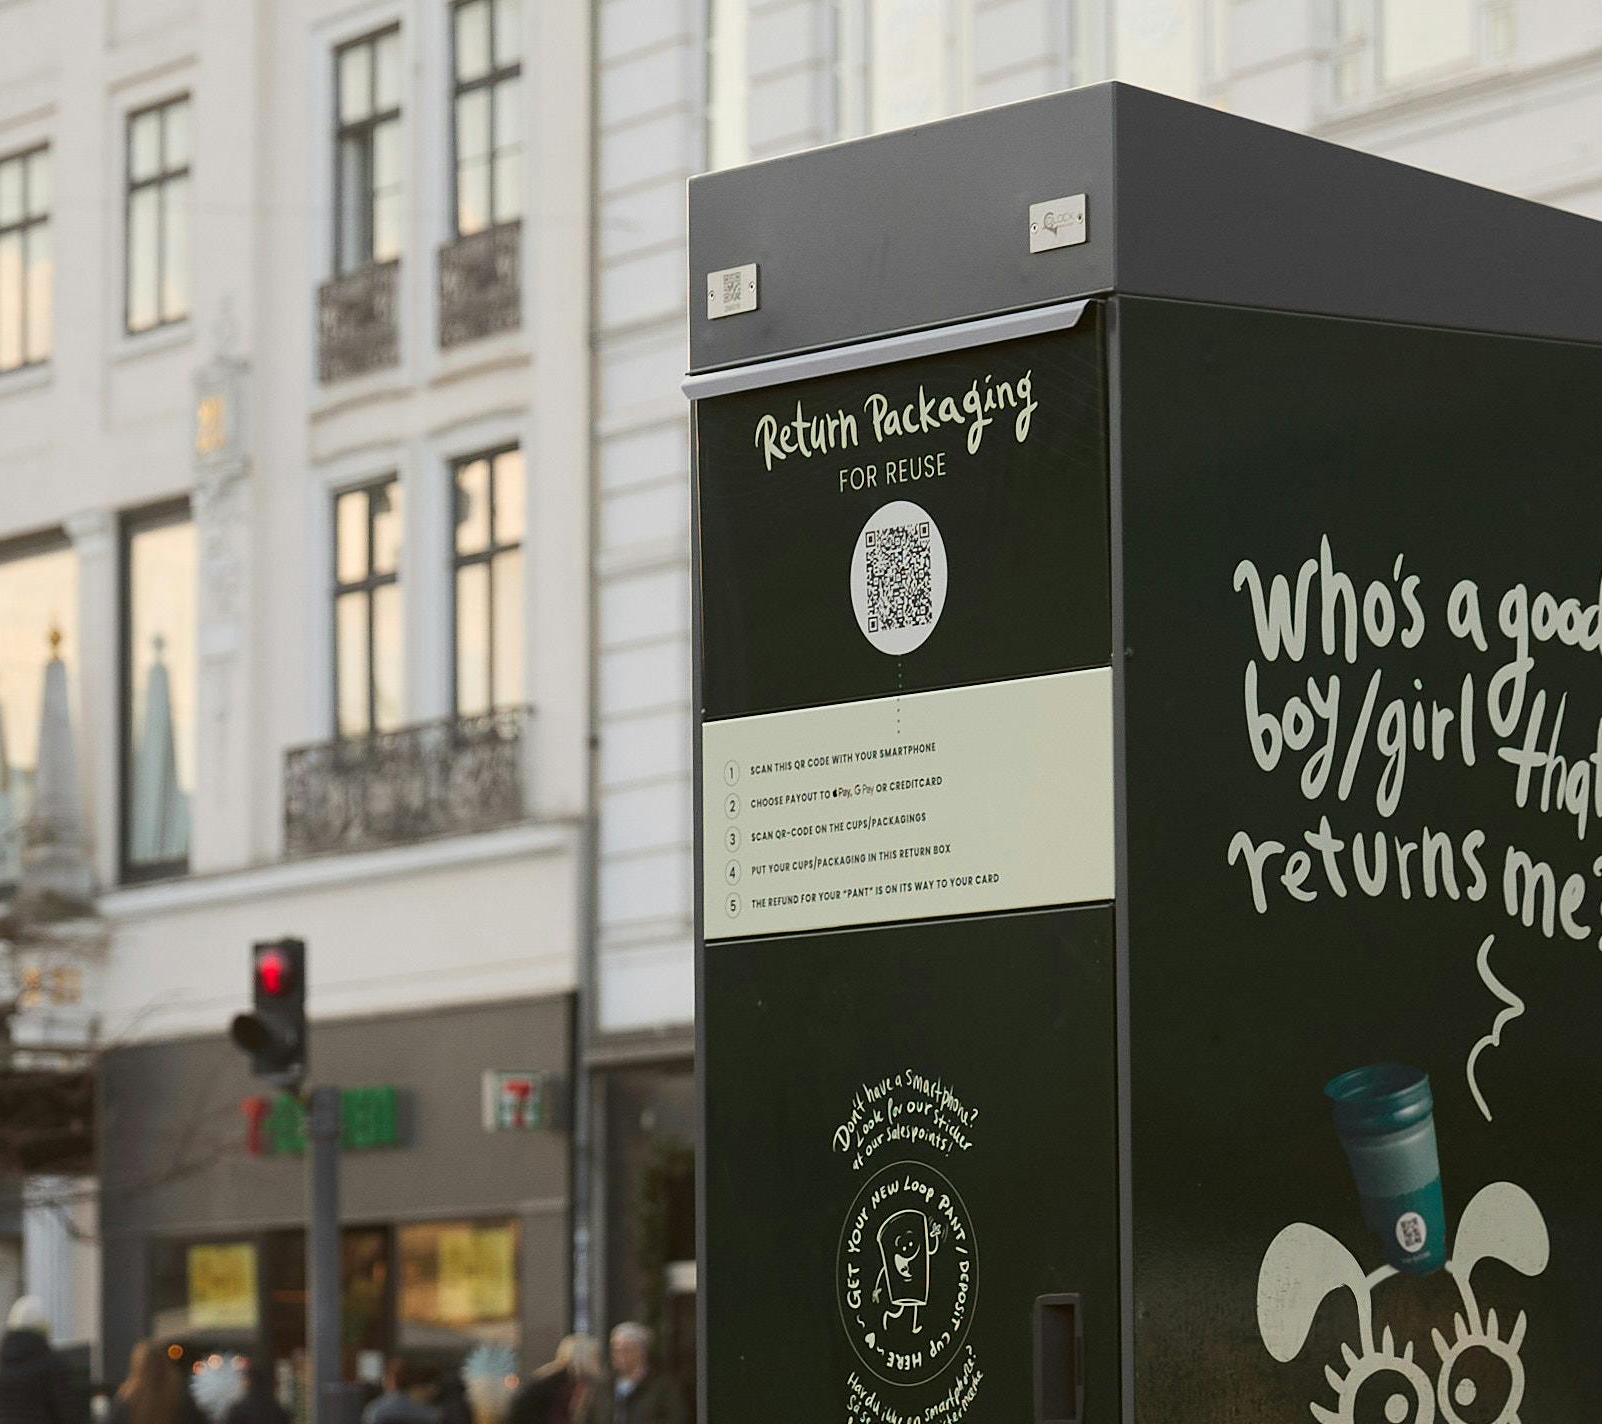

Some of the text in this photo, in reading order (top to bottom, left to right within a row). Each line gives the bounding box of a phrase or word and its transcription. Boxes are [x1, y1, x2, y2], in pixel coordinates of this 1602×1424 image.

[754, 368, 1039, 472] Return Packaging
[838, 452, 947, 493] FOR REUSE
[1232, 533, 1425, 665] Who's
[1446, 579, 1488, 653] a
[1242, 656, 1478, 818] boy/girl
[750, 764, 773, 776] SCAN
[775, 761, 792, 772] THIS
[794, 759, 806, 770] QR
[807, 756, 829, 768] CODE
[832, 753, 853, 765] WITH
[855, 750, 877, 762] YOUR
[879, 742, 936, 759] SMARTPHONE
[729, 800, 736, 812] 2
[751, 796, 783, 808] CHOOSE
[786, 791, 817, 804] PAYOUT
[820, 790, 831, 800] TO
[876, 782, 887, 793] OR
[889, 776, 943, 791] CREDITCARD
[730, 812, 926, 845] 3 SCAN QR-CODE ON THE CUPS/PACKAGINGS
[729, 844, 951, 879] 4 PUT YOUR CUPS/PACKAGING IN THIS RETURN BOX
[1226, 815, 1487, 916] returns
[730, 899, 736, 912] 5
[752, 898, 766, 909] THE
[768, 895, 799, 907] REFUND
[800, 892, 816, 903] FOR
[819, 890, 841, 902] YOUR
[876, 886, 883, 895] IS
[885, 884, 897, 894] ON
[900, 882, 912, 893] ITS
[915, 880, 934, 891] WAY
[936, 878, 947, 888] TO
[950, 876, 973, 887] YOUR
[975, 873, 999, 884] CARD
[832, 1091, 866, 1153] Don't
[862, 1078, 894, 1103] have
[895, 1074, 903, 1088] a
[856, 1097, 973, 1151] Look for our sticker
[852, 1151, 864, 1170] at
[865, 1133, 885, 1157] our
[871, 1179, 900, 1210] NEW
[847, 1207, 869, 1254] YOUR
[938, 1193, 966, 1241] PANT
[846, 1262, 862, 1309] GET
[886, 1351, 923, 1371] HERE
[929, 1332, 951, 1358] CUP
[864, 1391, 881, 1416] du
